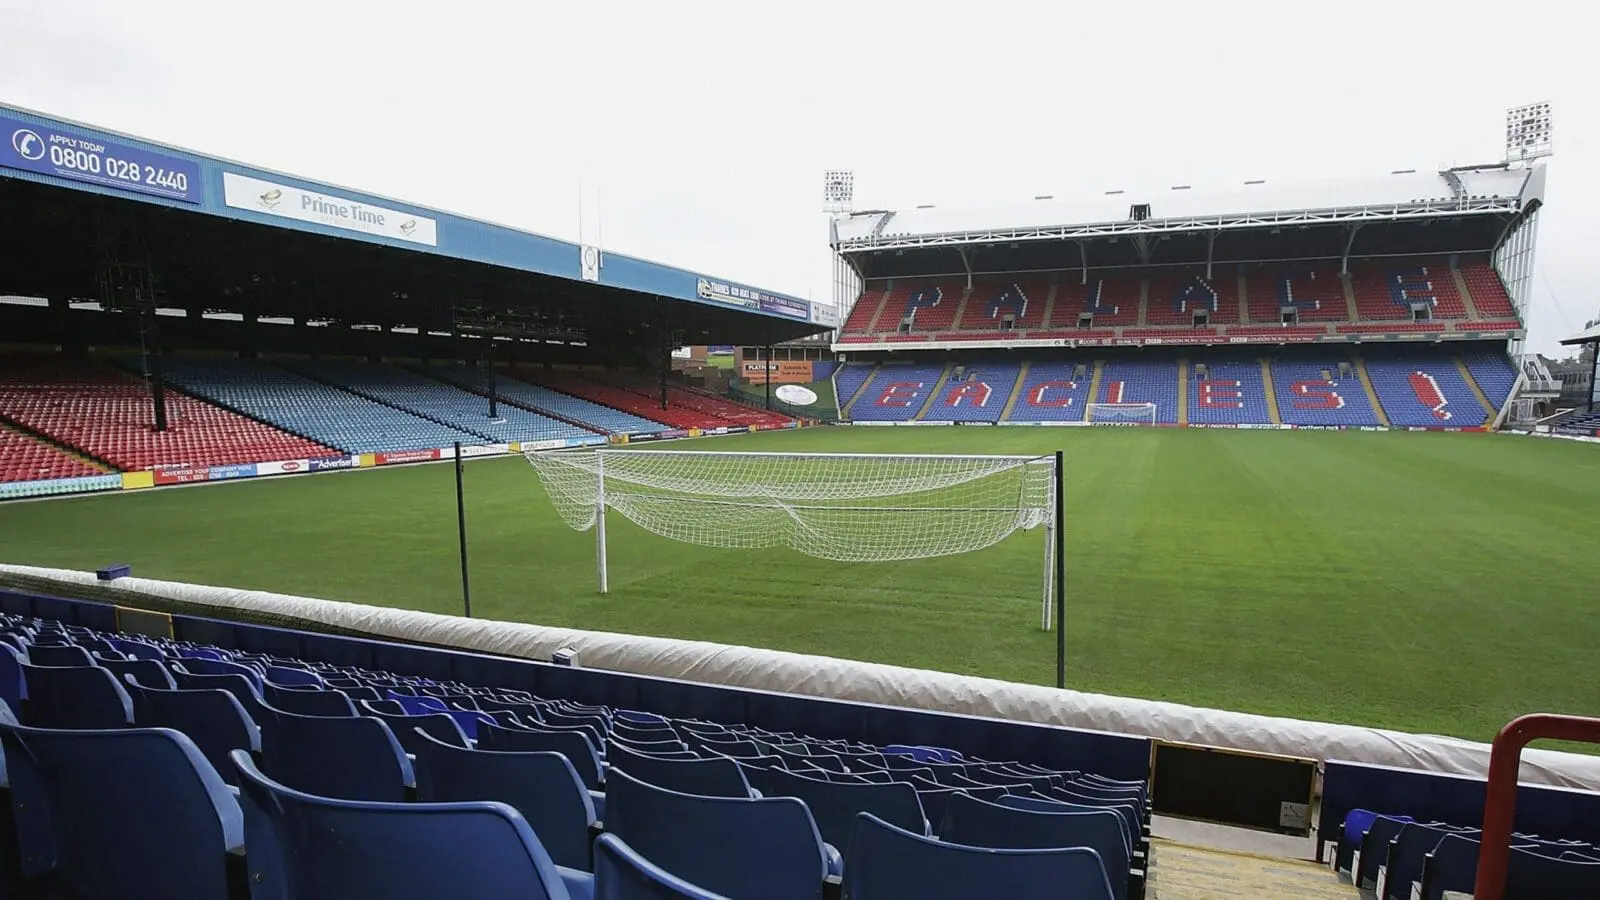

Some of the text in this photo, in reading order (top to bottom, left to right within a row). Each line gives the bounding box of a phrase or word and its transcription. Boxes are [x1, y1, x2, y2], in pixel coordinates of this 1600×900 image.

[49, 134, 105, 153] APPLY TODAY
[50, 145, 101, 174] 0800
[106, 157, 141, 182] 028
[144, 166, 187, 191] 2440
[301, 194, 348, 218] Prime
[350, 204, 385, 226] Time
[161, 469, 193, 477] ADVERTISE
[318, 458, 353, 469] Advertiser
